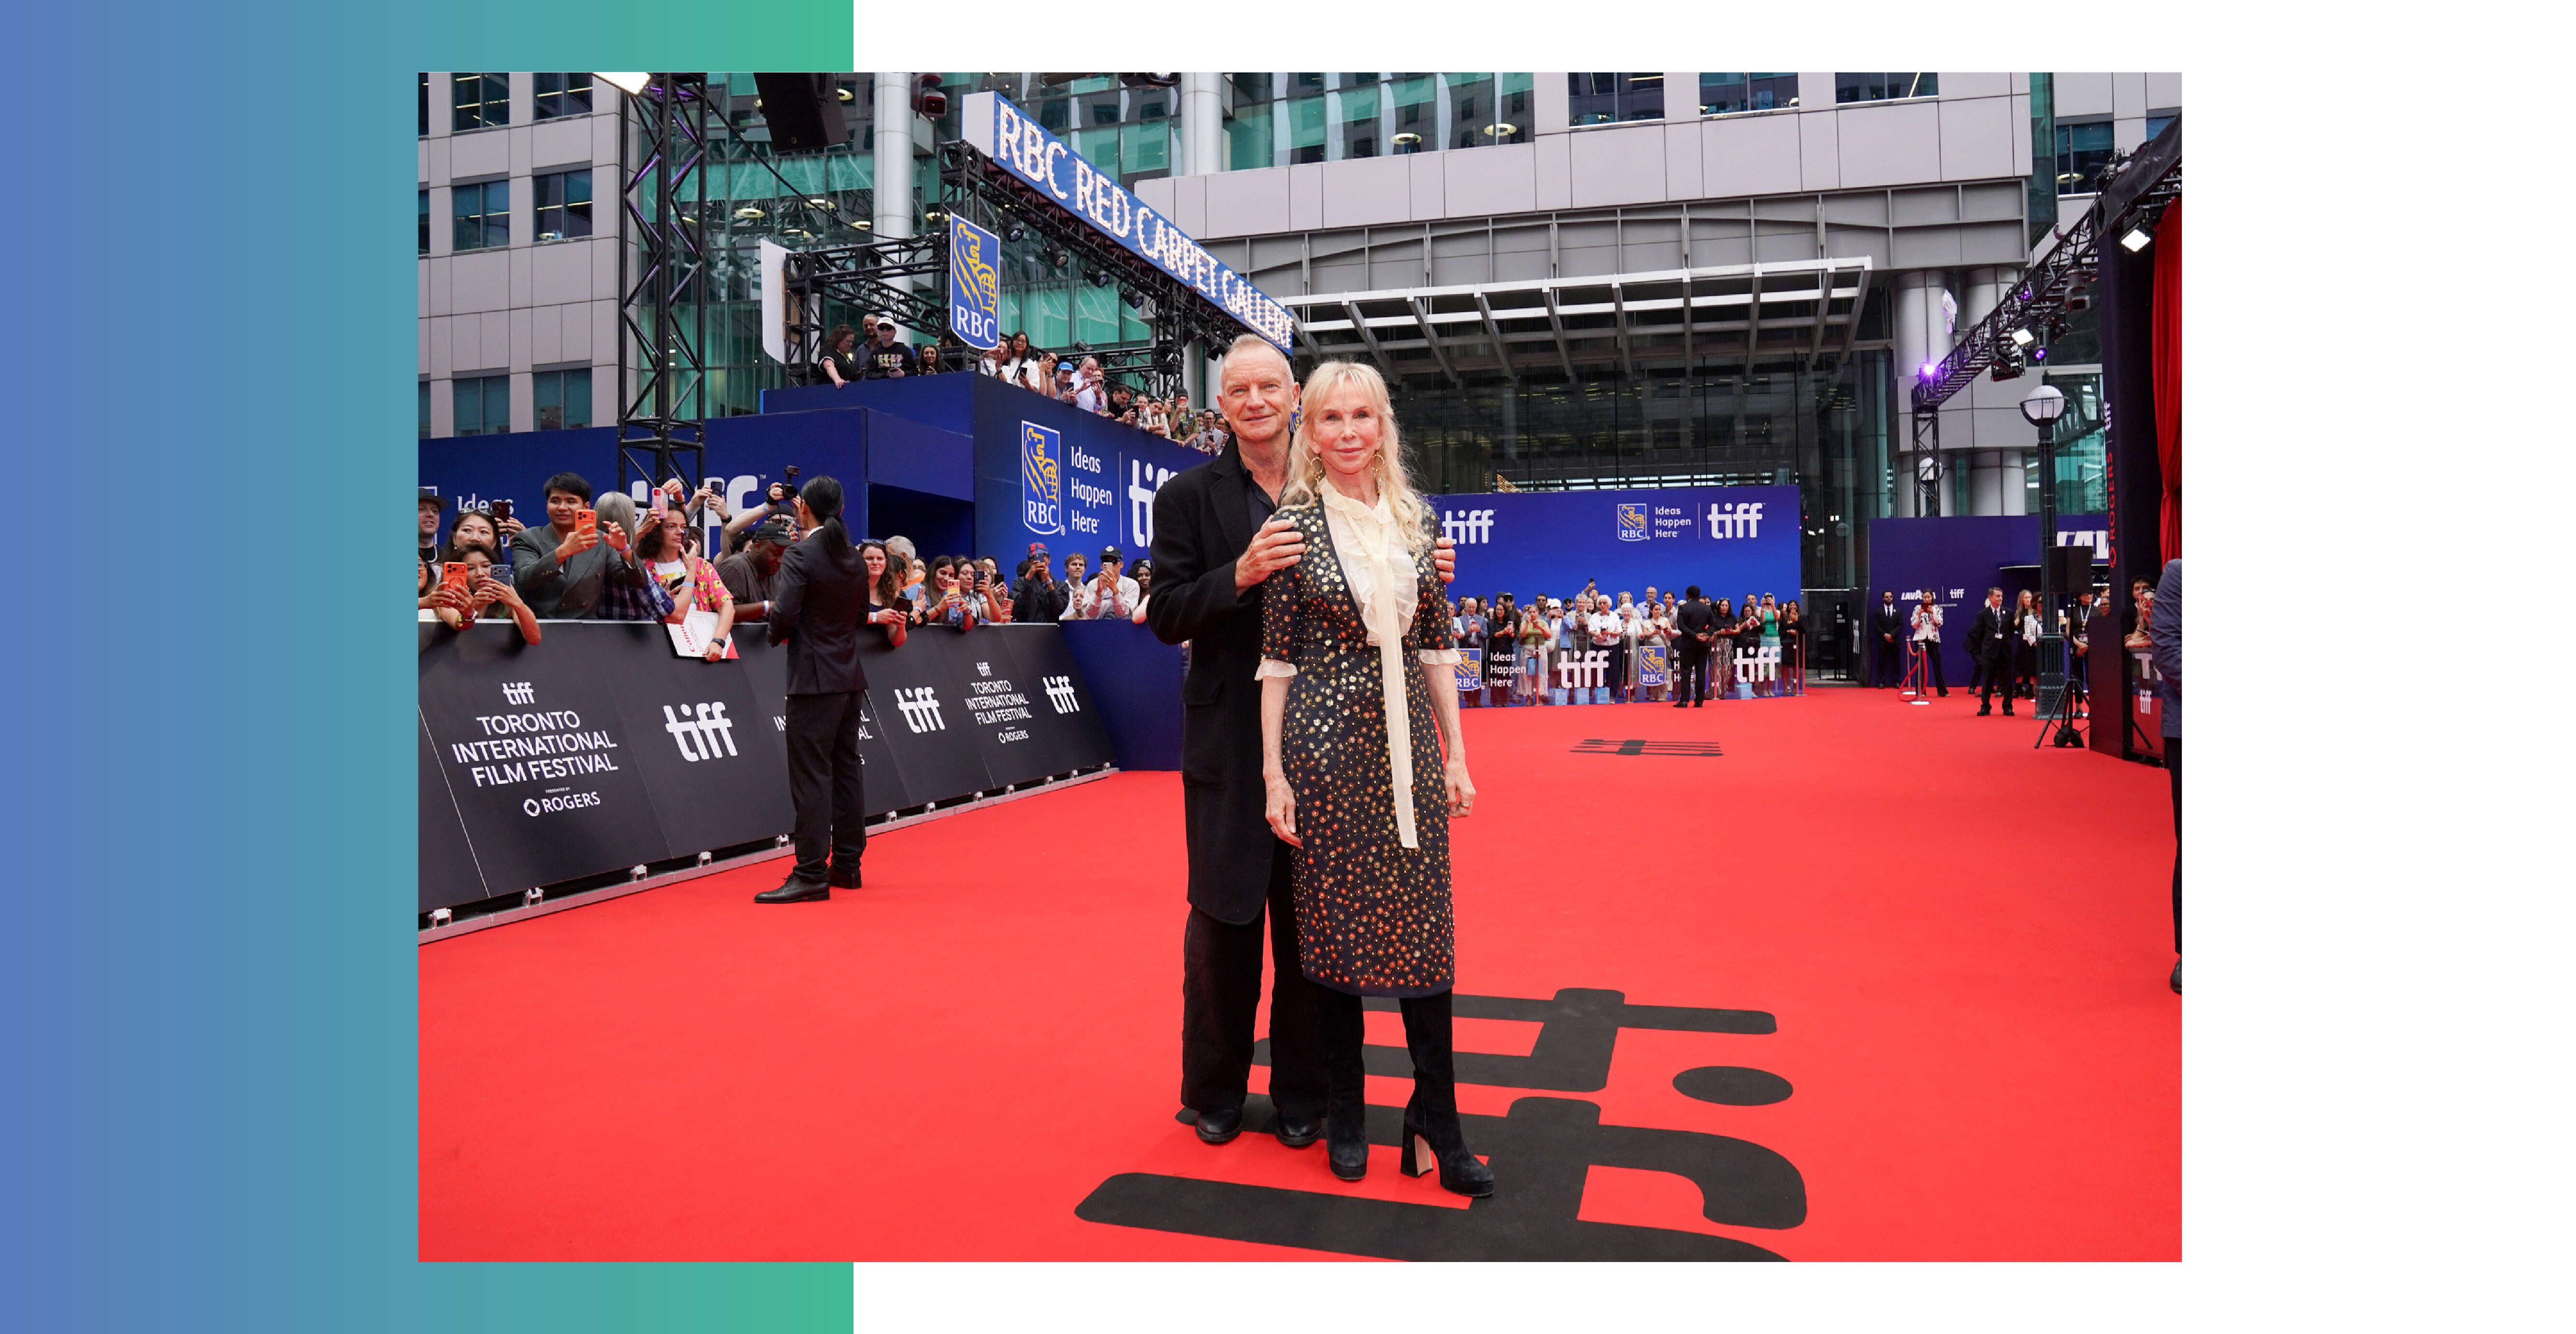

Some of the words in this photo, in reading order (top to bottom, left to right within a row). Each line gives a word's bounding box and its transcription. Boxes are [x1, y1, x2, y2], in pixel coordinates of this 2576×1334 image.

[997, 100, 1068, 200] RBC
[1074, 157, 1131, 238] RED
[1137, 207, 1219, 298] CARPET
[1222, 270, 1294, 349] GALLERY
[956, 305, 995, 343] RBC
[1070, 446, 1101, 473] Ideas
[1071, 477, 1112, 509] Happen
[1129, 459, 1179, 548] ti
[2107, 452, 2115, 540] ROGERS
[1027, 500, 1057, 526] RBC
[1071, 510, 1097, 534] Here
[1655, 507, 1681, 515] Ideas
[1655, 518, 1691, 528] Happen
[1708, 503, 1763, 539] tiff
[1442, 510, 1494, 545] tiff
[1622, 530, 1643, 538] RBC
[1950, 589, 1964, 598] tiff
[1490, 652, 1516, 661] Ideas
[1733, 646, 1779, 683] tiff
[977, 662, 991, 676] tiff
[1490, 665, 1526, 676] Happen
[1557, 650, 1609, 688] tiff
[1642, 674, 1664, 682] RBC
[502, 682, 535, 705] tiff
[970, 680, 1012, 695] TORONTO
[1043, 675, 1080, 714] tiff
[1456, 678, 1478, 688] RBC
[1490, 678, 1513, 687] Here
[895, 687, 945, 733] tiff
[965, 693, 1029, 710] INTERNATIONAL
[476, 710, 580, 735] TORONTO
[975, 711, 997, 725] FILM
[996, 707, 1032, 722] FESTIVAL
[663, 702, 738, 762] tiff
[1006, 730, 1029, 741] ROGERS
[452, 730, 618, 763] INTERNATIONAL
[471, 762, 527, 787] FILM
[527, 753, 618, 780] FESTIVAL
[541, 792, 600, 813] ROGERS
